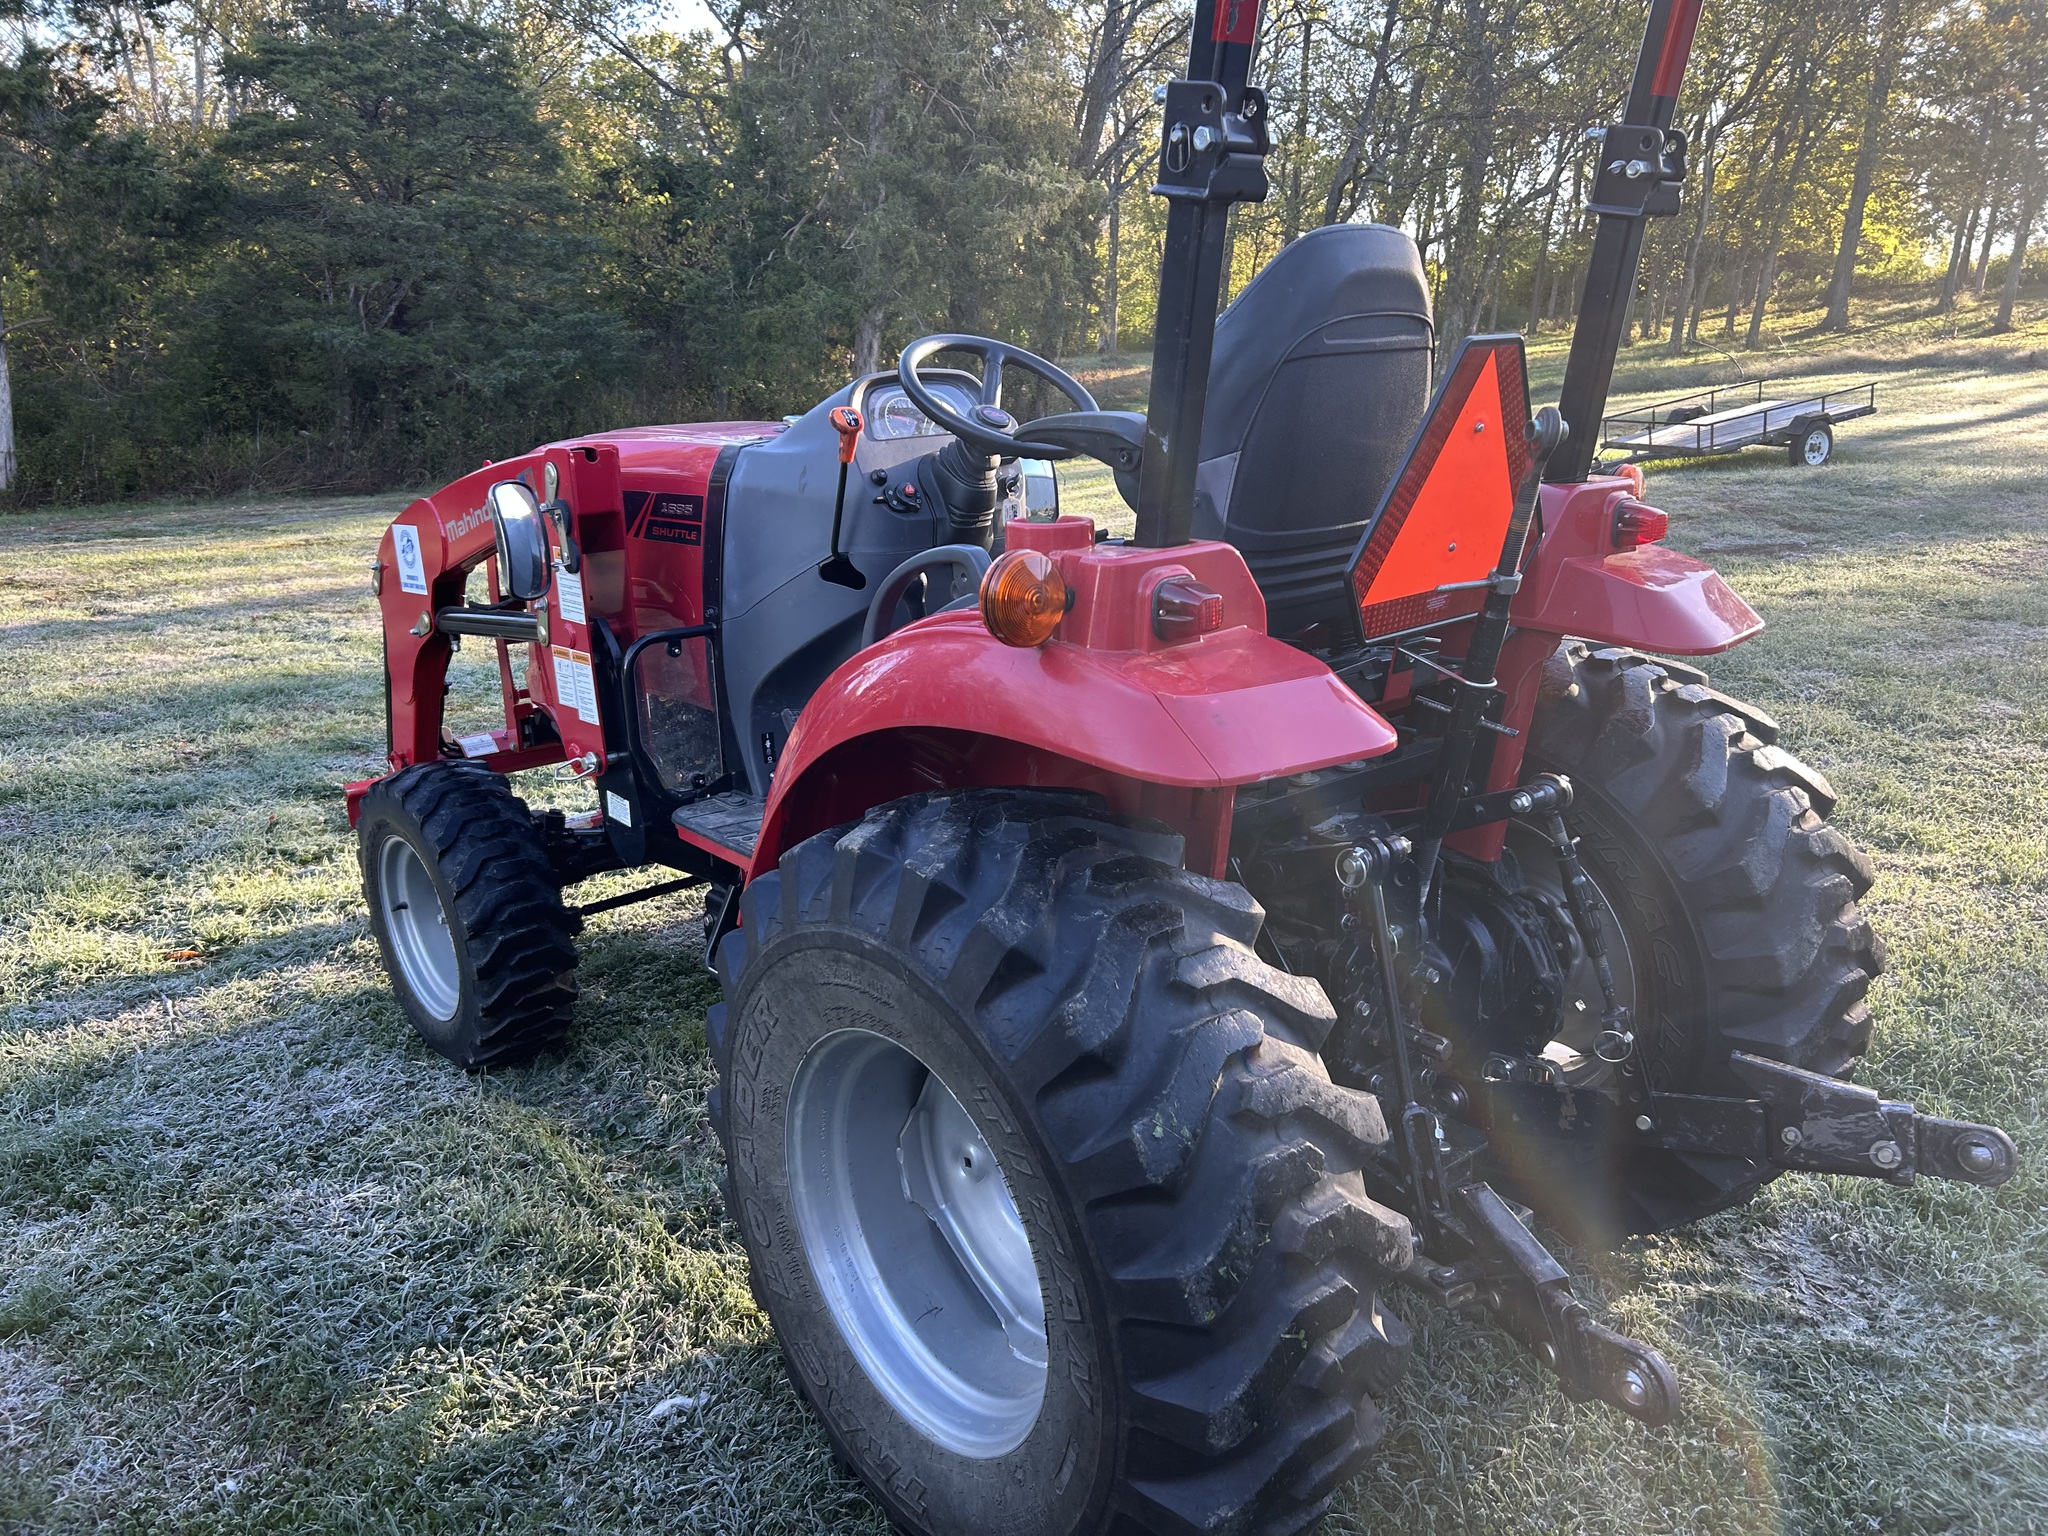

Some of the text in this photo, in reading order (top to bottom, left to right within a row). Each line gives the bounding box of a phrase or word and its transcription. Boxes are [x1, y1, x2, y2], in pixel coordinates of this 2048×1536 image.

[445, 498, 493, 543] Mahind
[652, 526, 698, 540] SHUTTLE
[1568, 807, 1686, 990] TRAC
[734, 993, 928, 1515] TRAC LOADER
[972, 1083, 1095, 1413] TITAN
